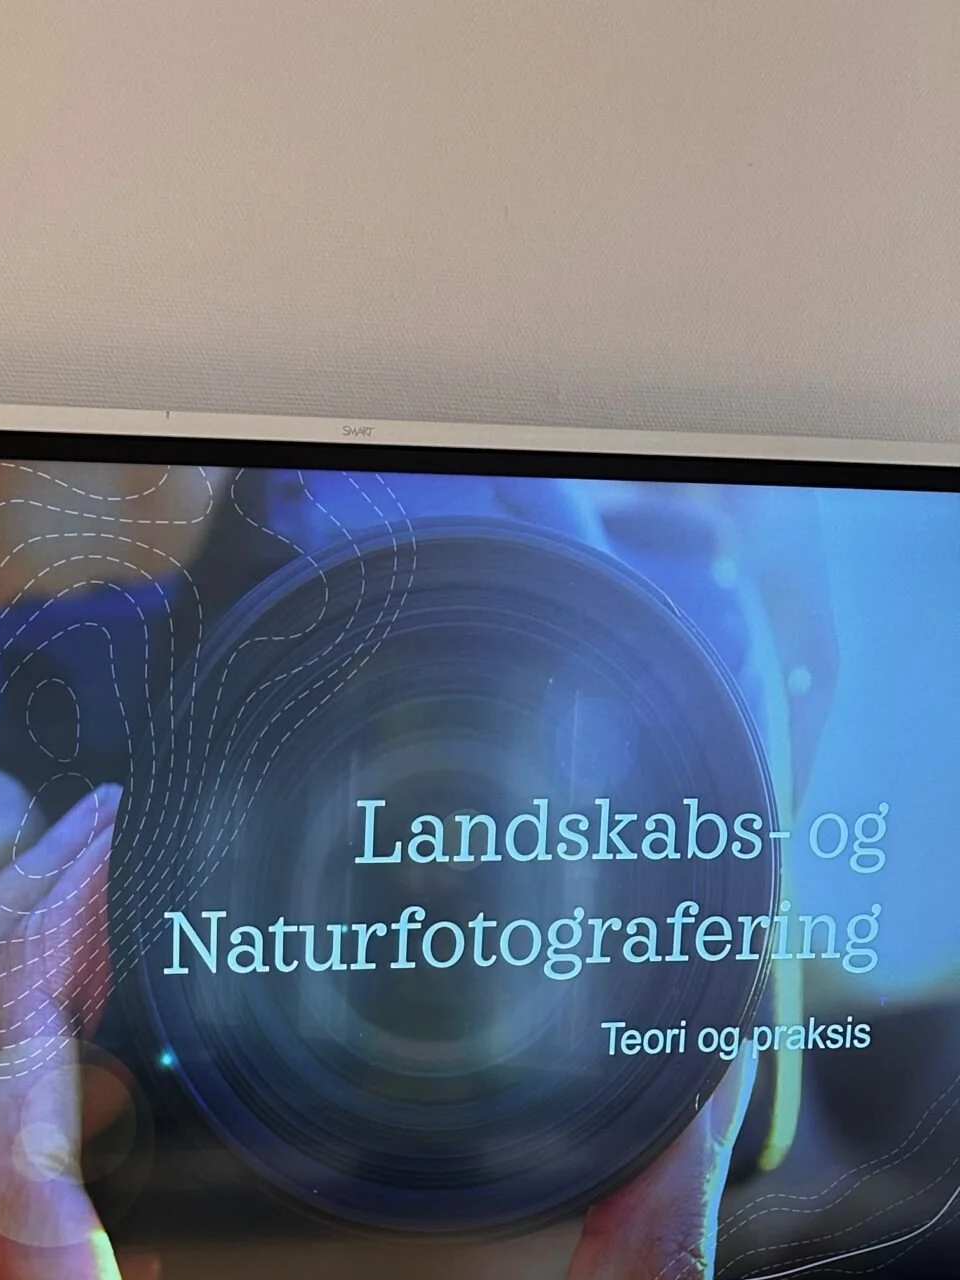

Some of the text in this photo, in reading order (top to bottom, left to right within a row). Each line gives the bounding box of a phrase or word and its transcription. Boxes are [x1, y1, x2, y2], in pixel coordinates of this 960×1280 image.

[342, 425, 375, 437] SMART
[353, 797, 889, 873] Landskabs- og
[162, 899, 882, 980] Naturfotografering
[601, 1017, 872, 1059] Teori og praksis
